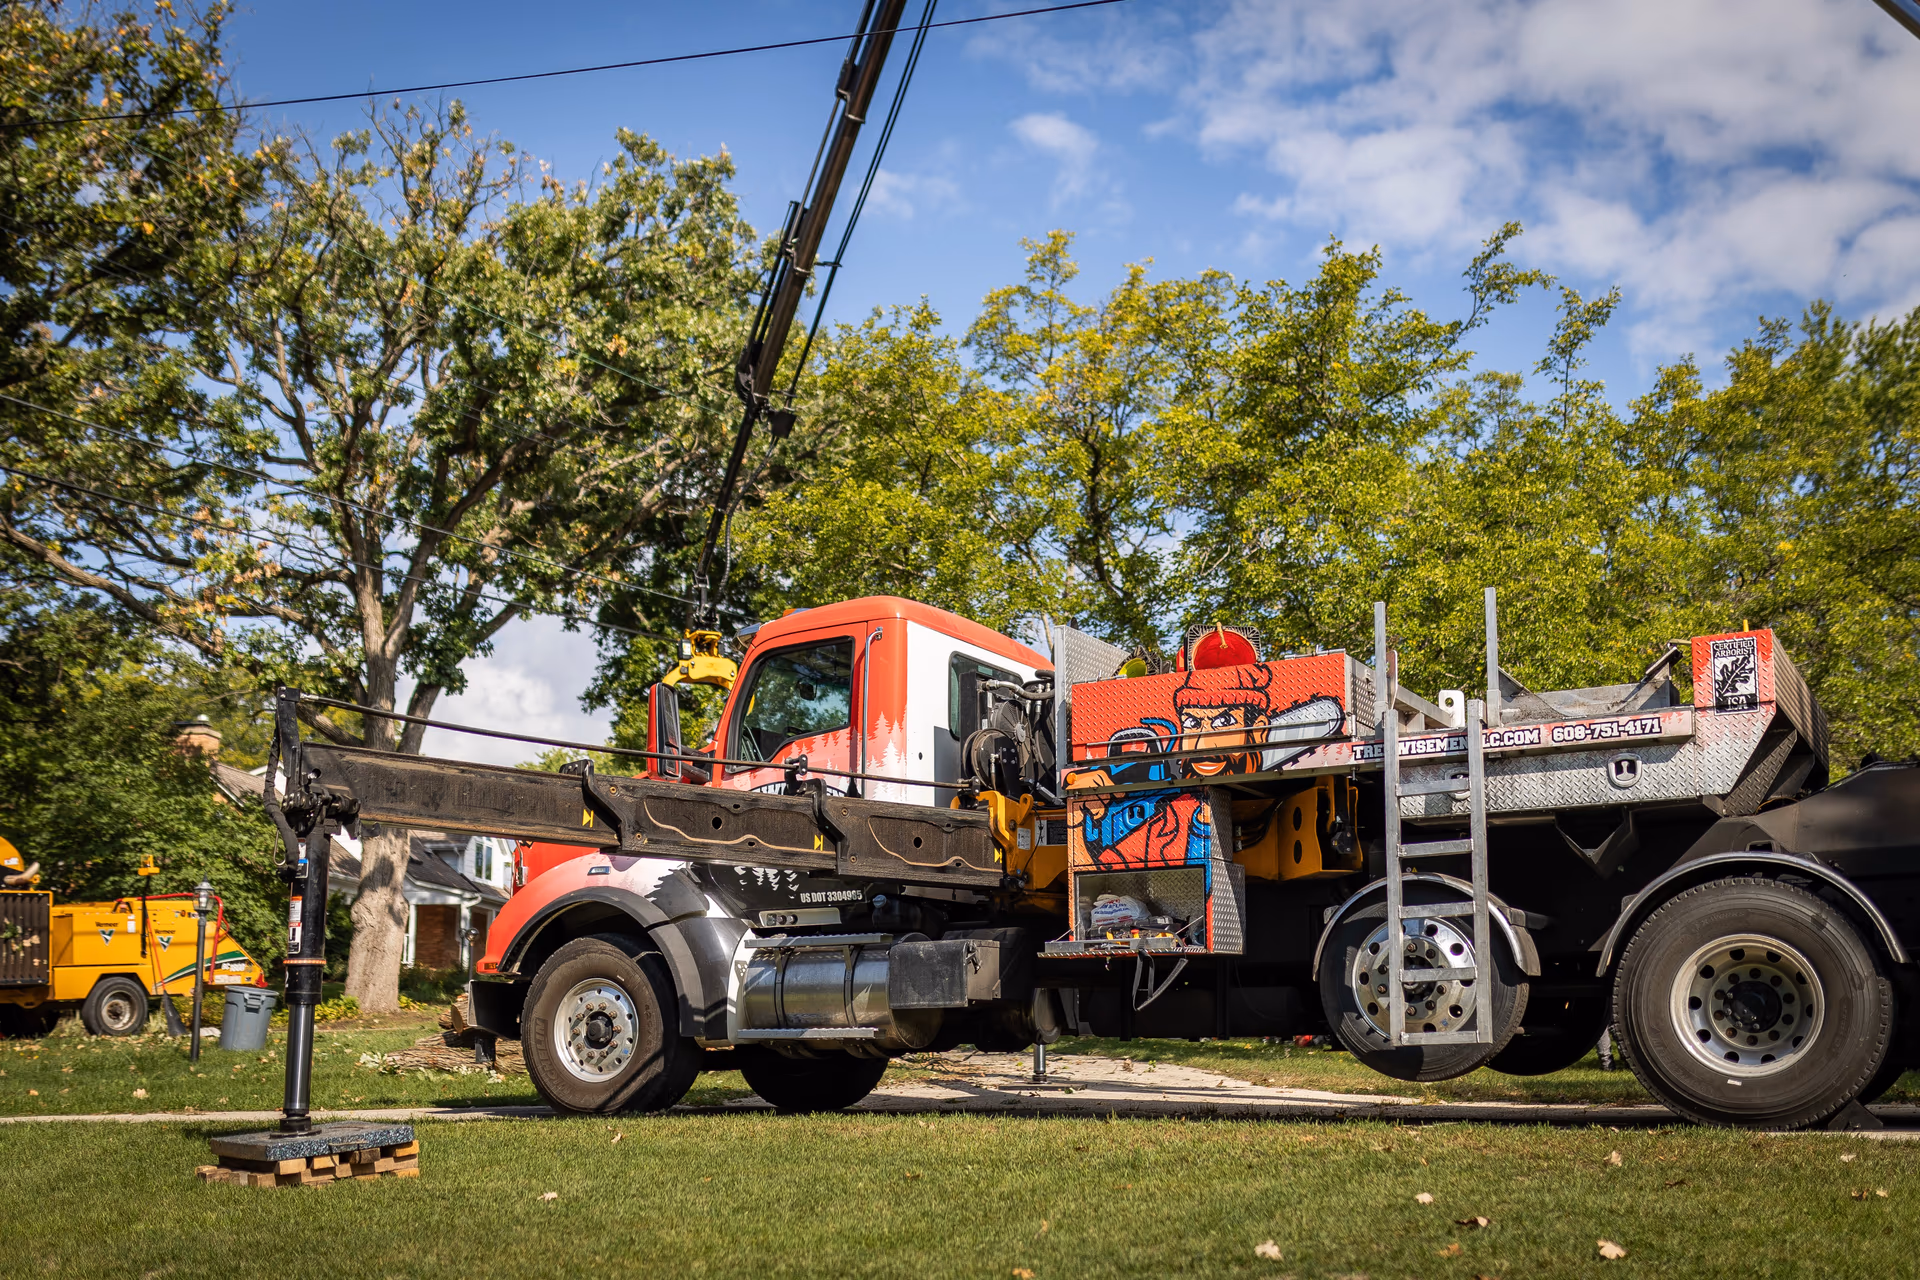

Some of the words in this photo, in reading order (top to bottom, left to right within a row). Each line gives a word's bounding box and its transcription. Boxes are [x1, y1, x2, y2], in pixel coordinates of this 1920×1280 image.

[1714, 640, 1753, 650] CERTIFIED
[1715, 647, 1753, 657] ARBORIST
[1726, 696, 1748, 710] ISA
[1353, 729, 1540, 759] TREWISEMENLC.COM
[1553, 718, 1661, 742] 608-751-4171
[800, 893, 811, 903] US
[811, 892, 826, 902] DOT
[827, 890, 863, 902] 3304985
[534, 1017, 570, 1094] MICHELIN
